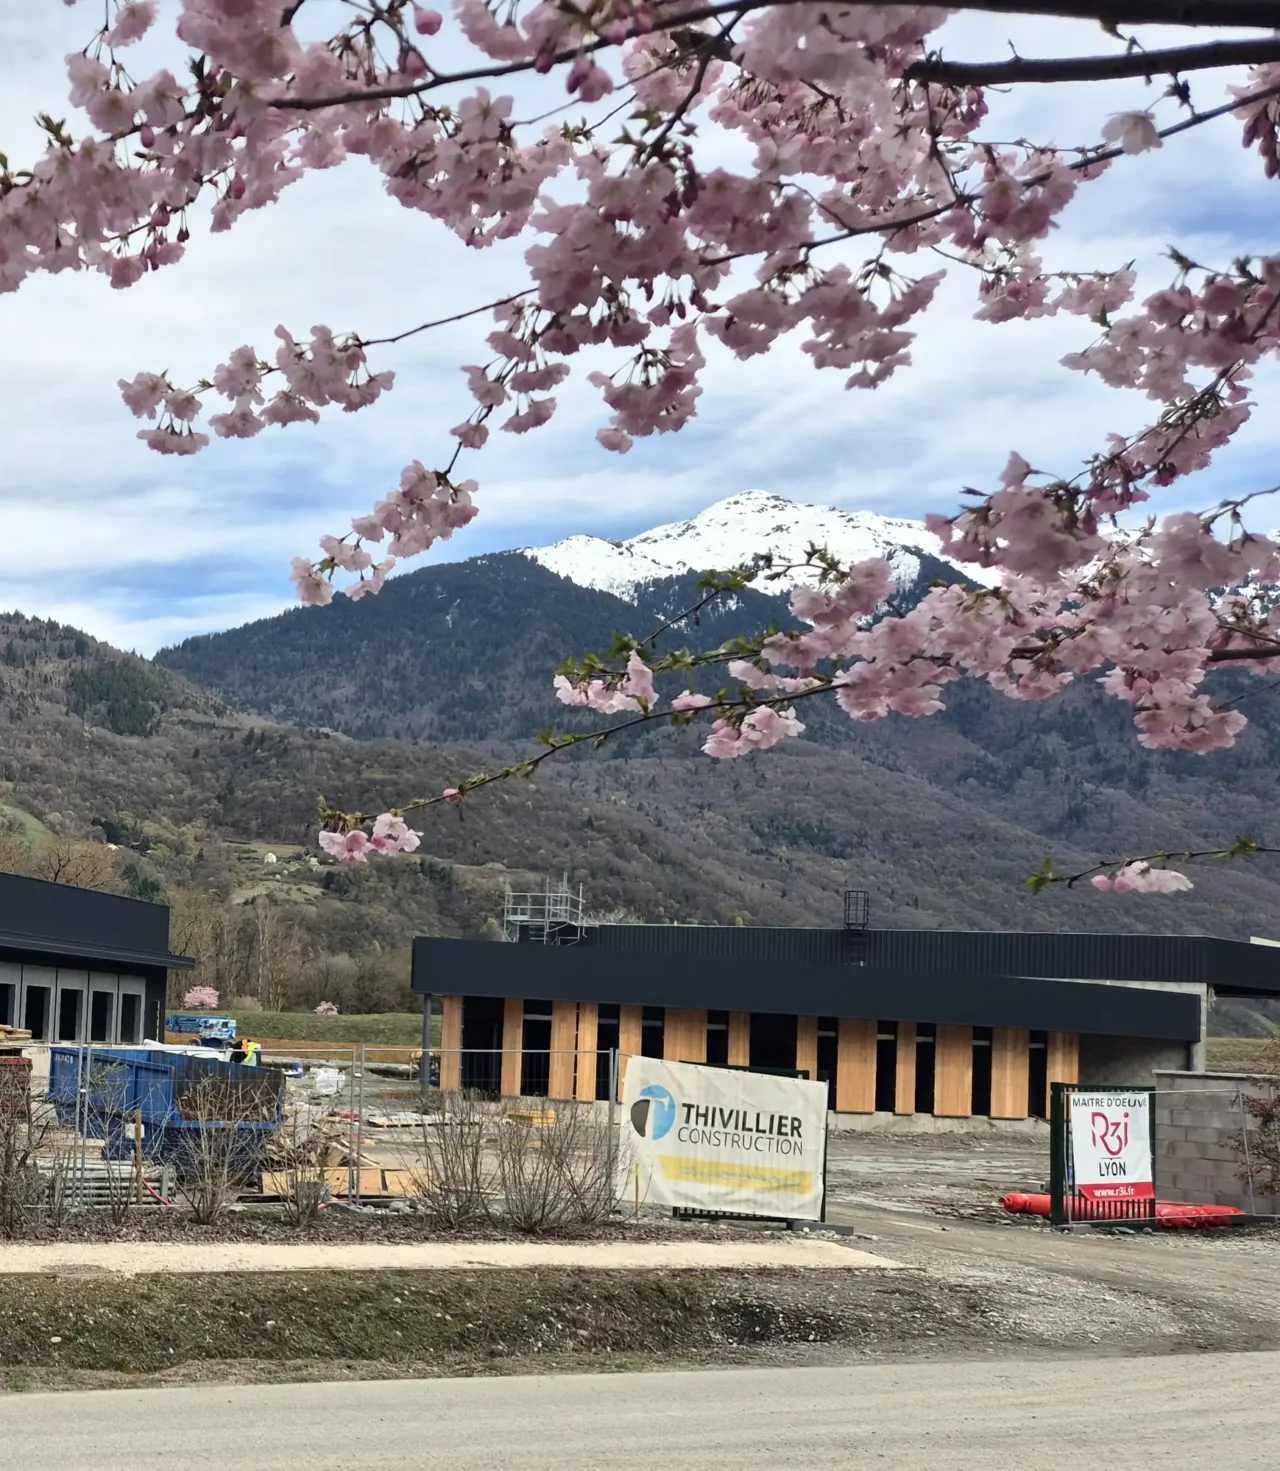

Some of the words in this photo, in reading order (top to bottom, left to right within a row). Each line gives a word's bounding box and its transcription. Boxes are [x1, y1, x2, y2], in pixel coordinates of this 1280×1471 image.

[1073, 1097, 1104, 1107] MAITRE
[682, 1103, 802, 1138] THIVILLIER
[677, 1127, 803, 1156] CONSTRUCTION
[1091, 1112, 1129, 1156] R3i
[1099, 1162, 1126, 1177] LYON
[1093, 1186, 1134, 1196] www.r3i.fr
